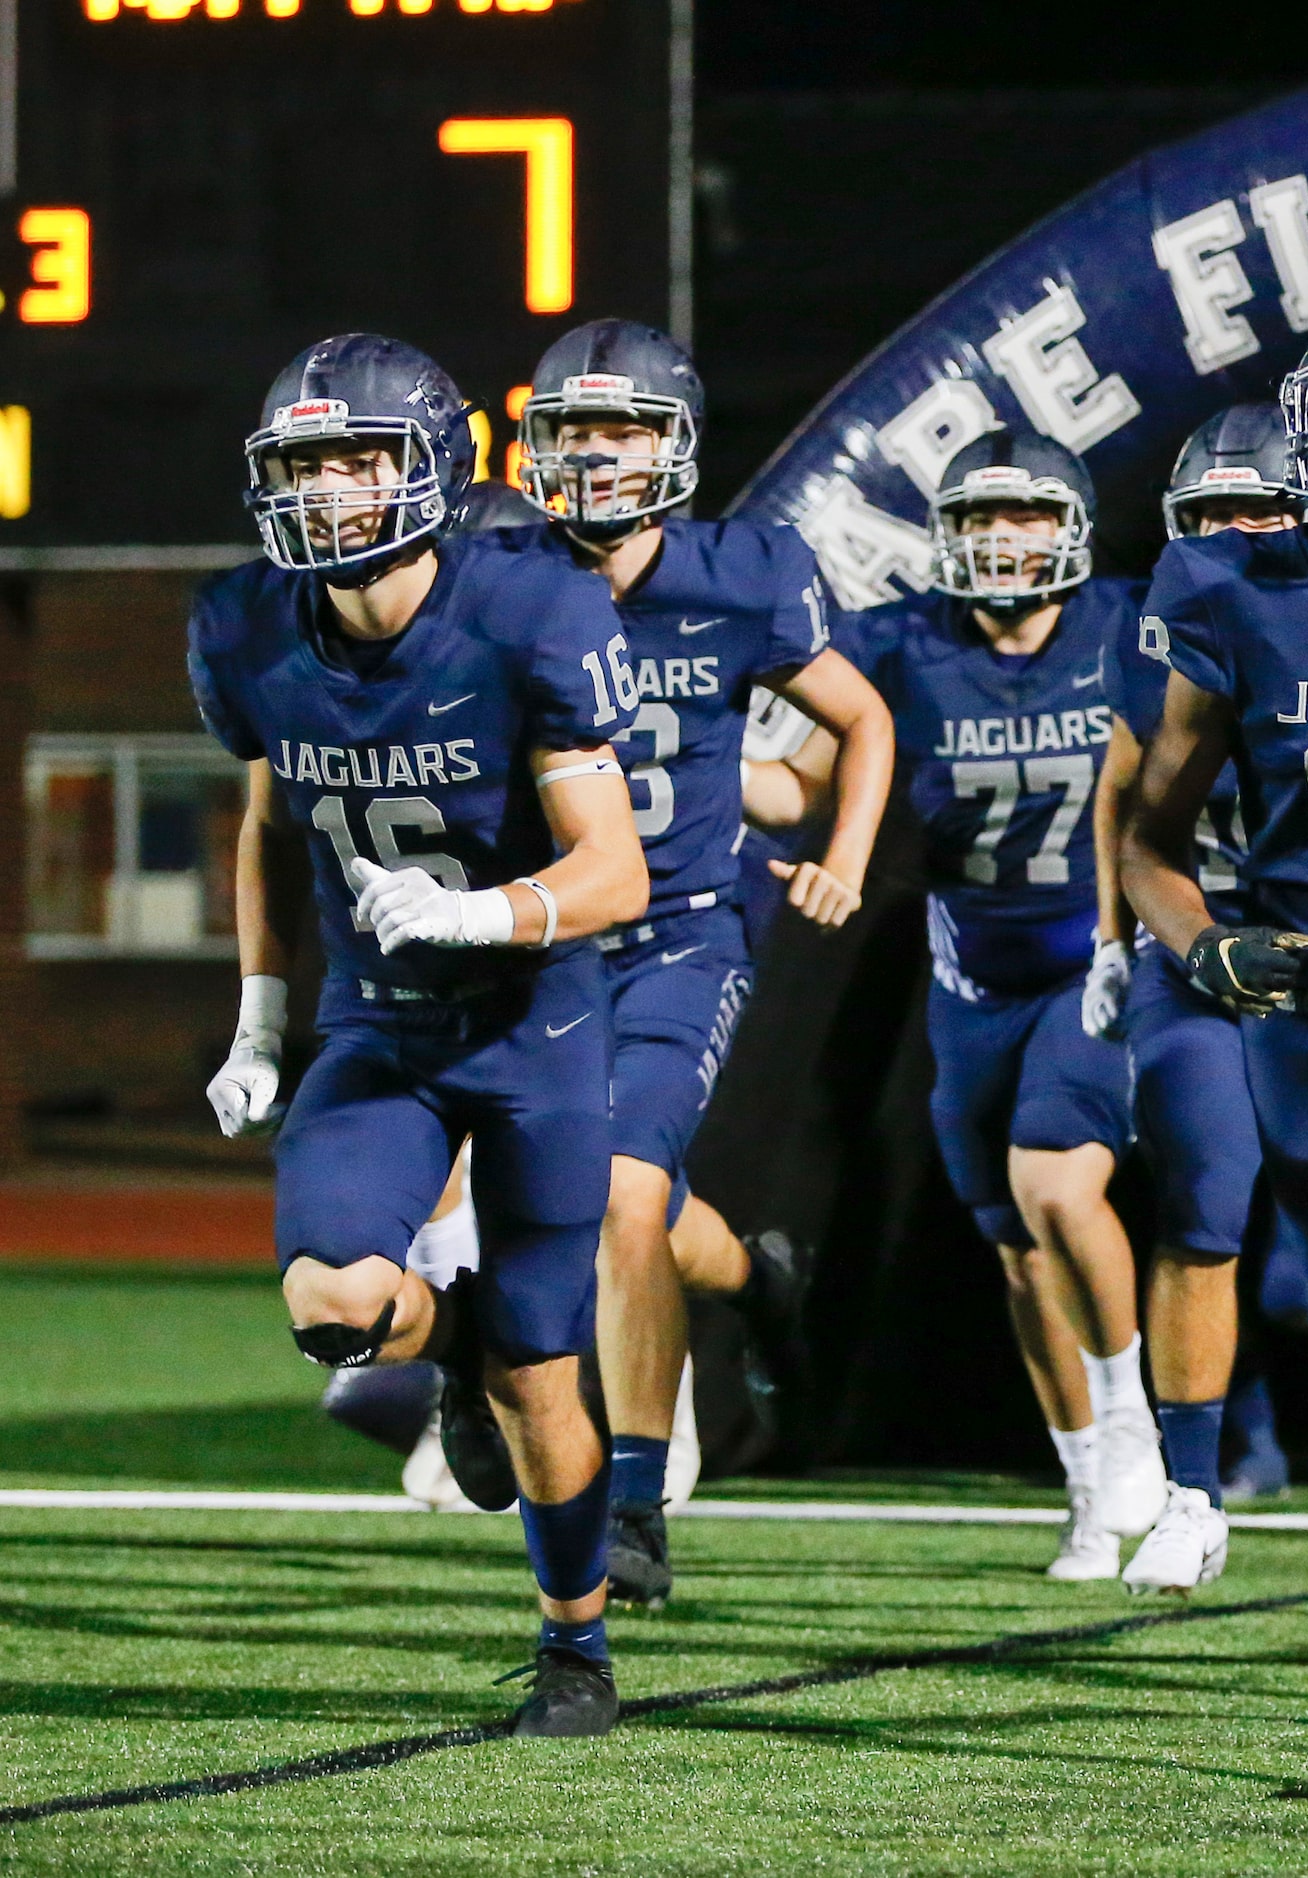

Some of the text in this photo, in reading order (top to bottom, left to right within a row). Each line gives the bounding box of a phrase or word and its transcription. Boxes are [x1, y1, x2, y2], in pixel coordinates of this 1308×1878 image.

[439, 117, 573, 314] 7
[582, 633, 640, 727] 16
[934, 705, 1112, 757] JAGUARS
[273, 739, 481, 787] JAGUARS
[952, 753, 1094, 884] 77
[311, 796, 471, 932] 16
